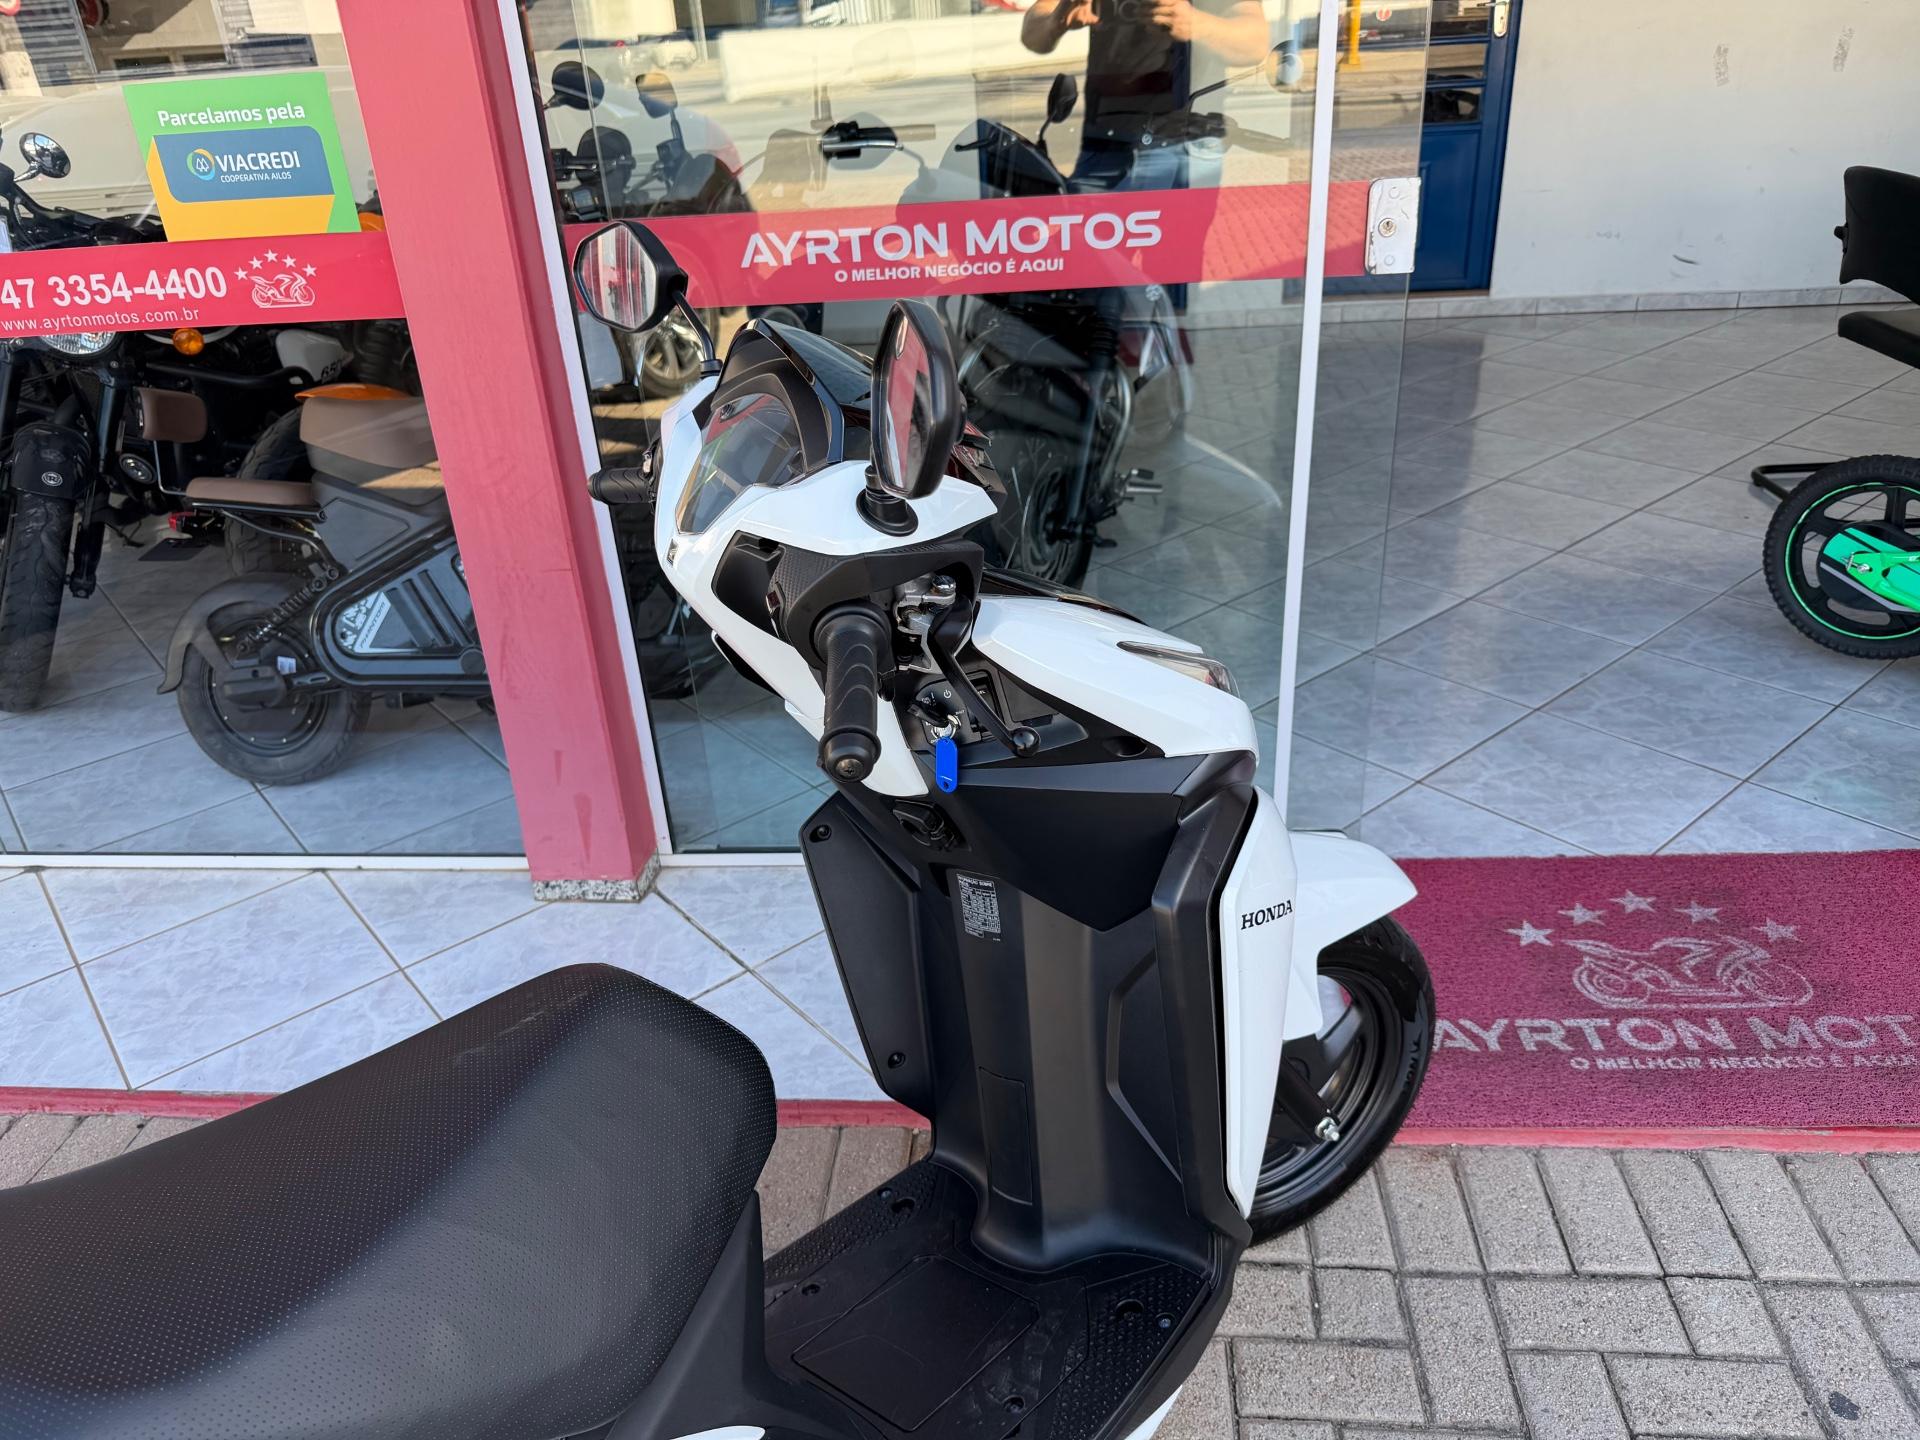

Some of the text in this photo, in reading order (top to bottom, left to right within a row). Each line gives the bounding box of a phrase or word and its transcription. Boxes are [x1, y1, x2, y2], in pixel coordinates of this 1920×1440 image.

[157, 102, 305, 127] Parcelamos pela
[215, 151, 301, 172] VIACREDI
[220, 172, 292, 183] COOPERATIVA AILOS
[741, 210, 1162, 268] AYRTON MOTOS
[834, 257, 1064, 283] O MELHOR NEGÓCIO É AQUI
[0, 266, 227, 310] 47 3354-4400
[1, 307, 199, 331] www.ayrtonmotos.com.br
[1240, 899, 1293, 931] HONDA
[1432, 1016, 1738, 1052] AYRTON
[1570, 1056, 1590, 1070] O
[1595, 1056, 1702, 1071] MELHOR
